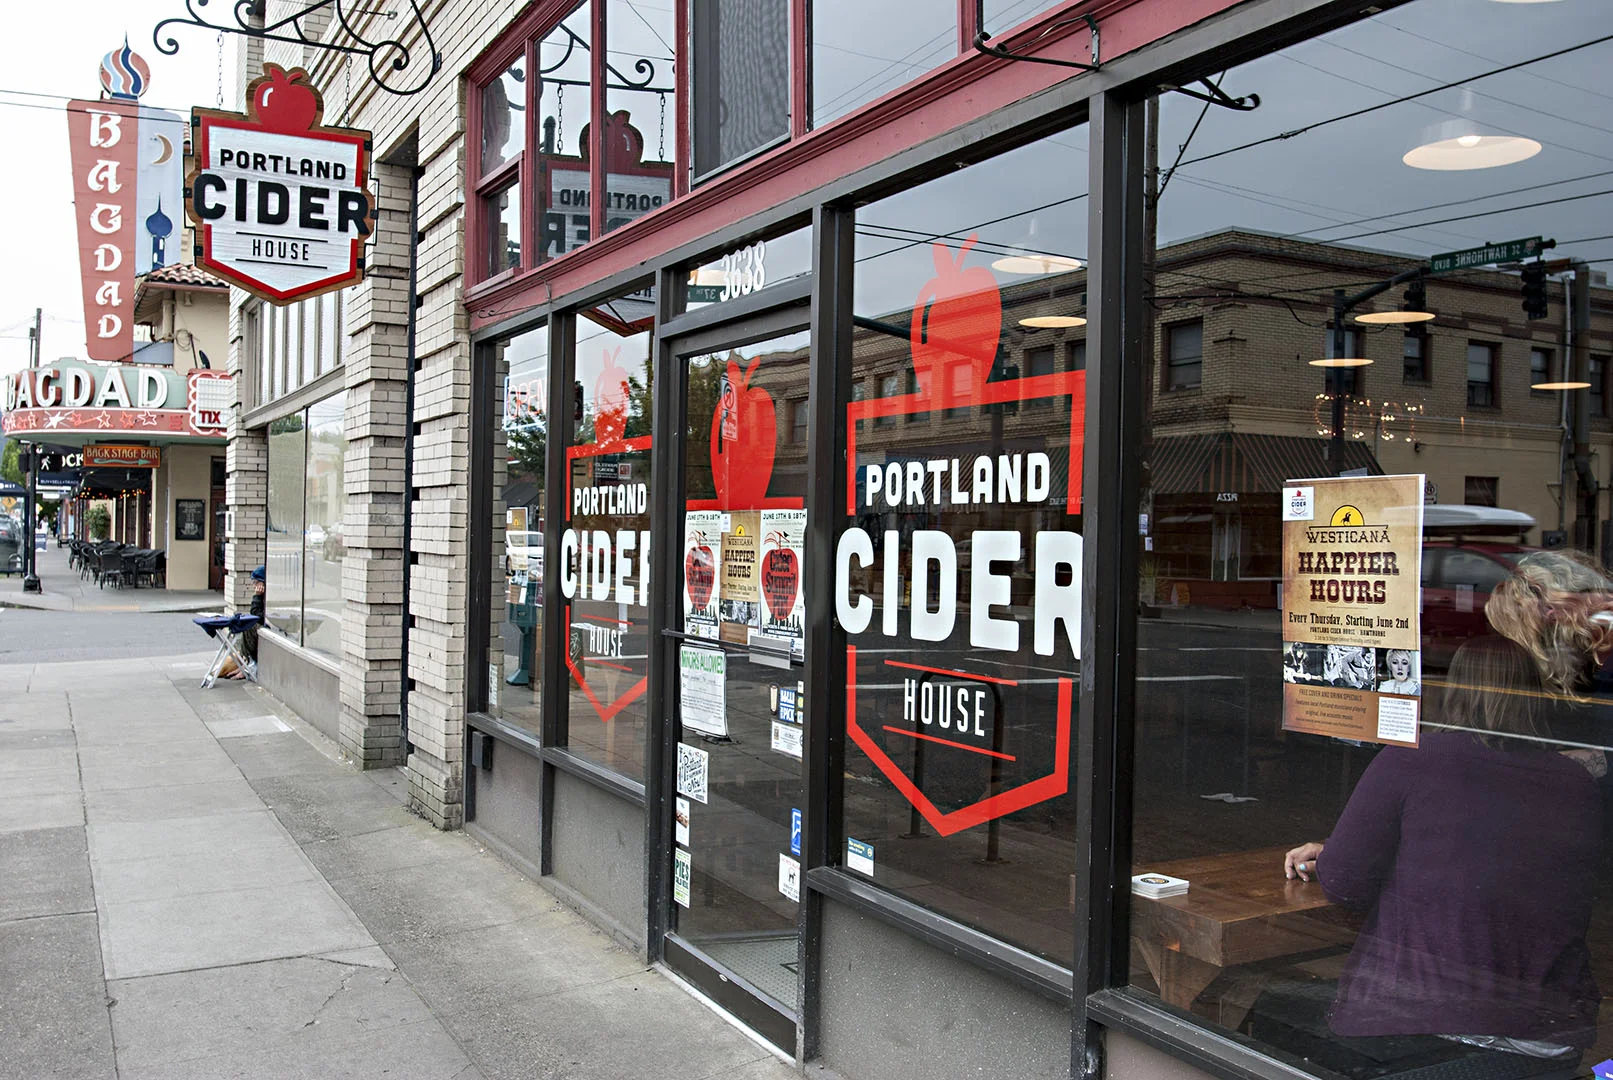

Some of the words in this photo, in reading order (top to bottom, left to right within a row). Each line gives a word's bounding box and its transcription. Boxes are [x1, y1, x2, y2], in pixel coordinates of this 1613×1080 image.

[219, 148, 346, 181] PORTLAND
[194, 173, 371, 235] CIDER
[85, 107, 124, 339] BAGDAD
[252, 239, 310, 261] HOUSE
[720, 240, 767, 301] 3638
[6, 366, 168, 411] BAGDAD
[198, 410, 221, 425] TIX
[87, 448, 110, 459] BACK
[112, 448, 138, 459] STAGE
[140, 449, 158, 460] BAR
[866, 452, 1050, 507] PORTLAND
[574, 483, 647, 516] PORTLAND
[1305, 530, 1391, 544] WESTICANA
[725, 549, 755, 564] HAPPIER
[1298, 551, 1399, 576] HAPPIER
[728, 564, 751, 578] HOURS
[836, 527, 1083, 660] CIDER
[1310, 579, 1386, 604] HOURS
[1289, 612, 1307, 624] Every
[1346, 614, 1373, 629] Starting
[1376, 616, 1393, 628] June
[1395, 618, 1409, 629] 2nd
[589, 630, 623, 658] HOUSE
[700, 655, 723, 674] ALLOWED
[904, 678, 986, 737] HOUSE
[675, 859, 689, 881] PIES
